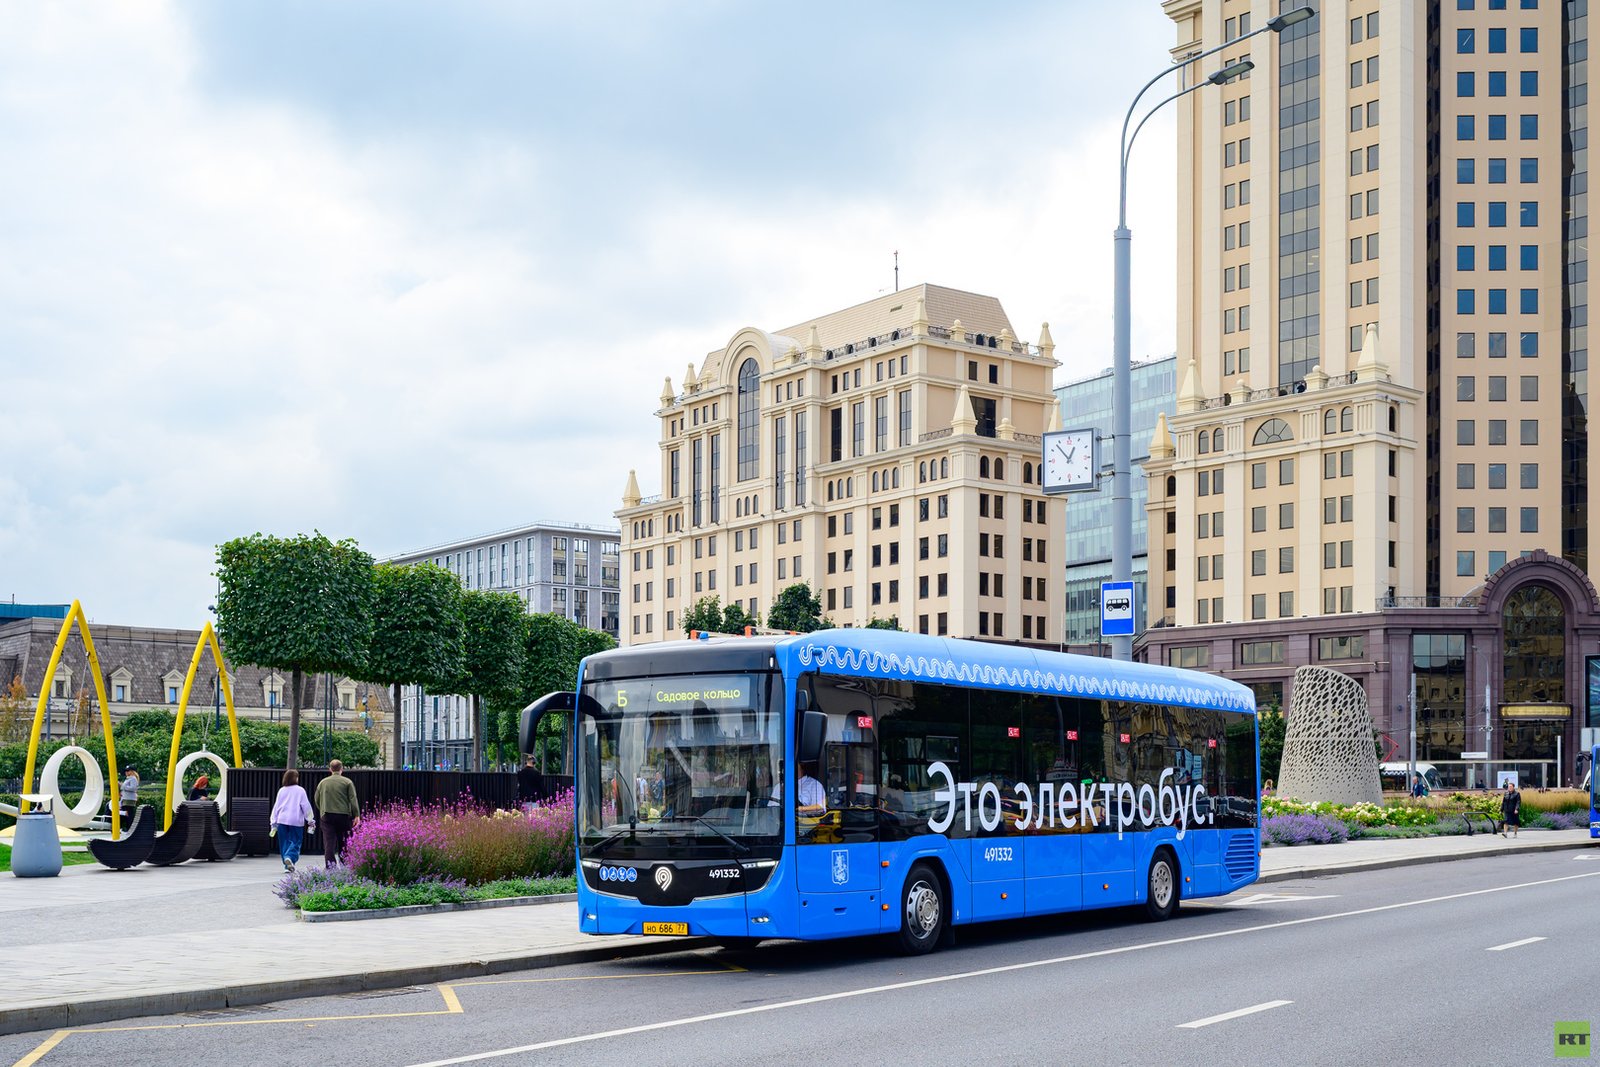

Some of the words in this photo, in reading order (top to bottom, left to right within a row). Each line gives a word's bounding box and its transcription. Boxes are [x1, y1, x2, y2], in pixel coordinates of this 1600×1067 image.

[617, 690, 628, 707] Б
[656, 690, 700, 703] Садовое
[703, 689, 741, 700] кольцо
[927, 761, 1001, 833] Это
[1014, 767, 1214, 841] электробус.
[984, 847, 1013, 861] 491332
[709, 869, 740, 878] 491332
[659, 923, 673, 933] 686
[677, 923, 685, 931] 77
